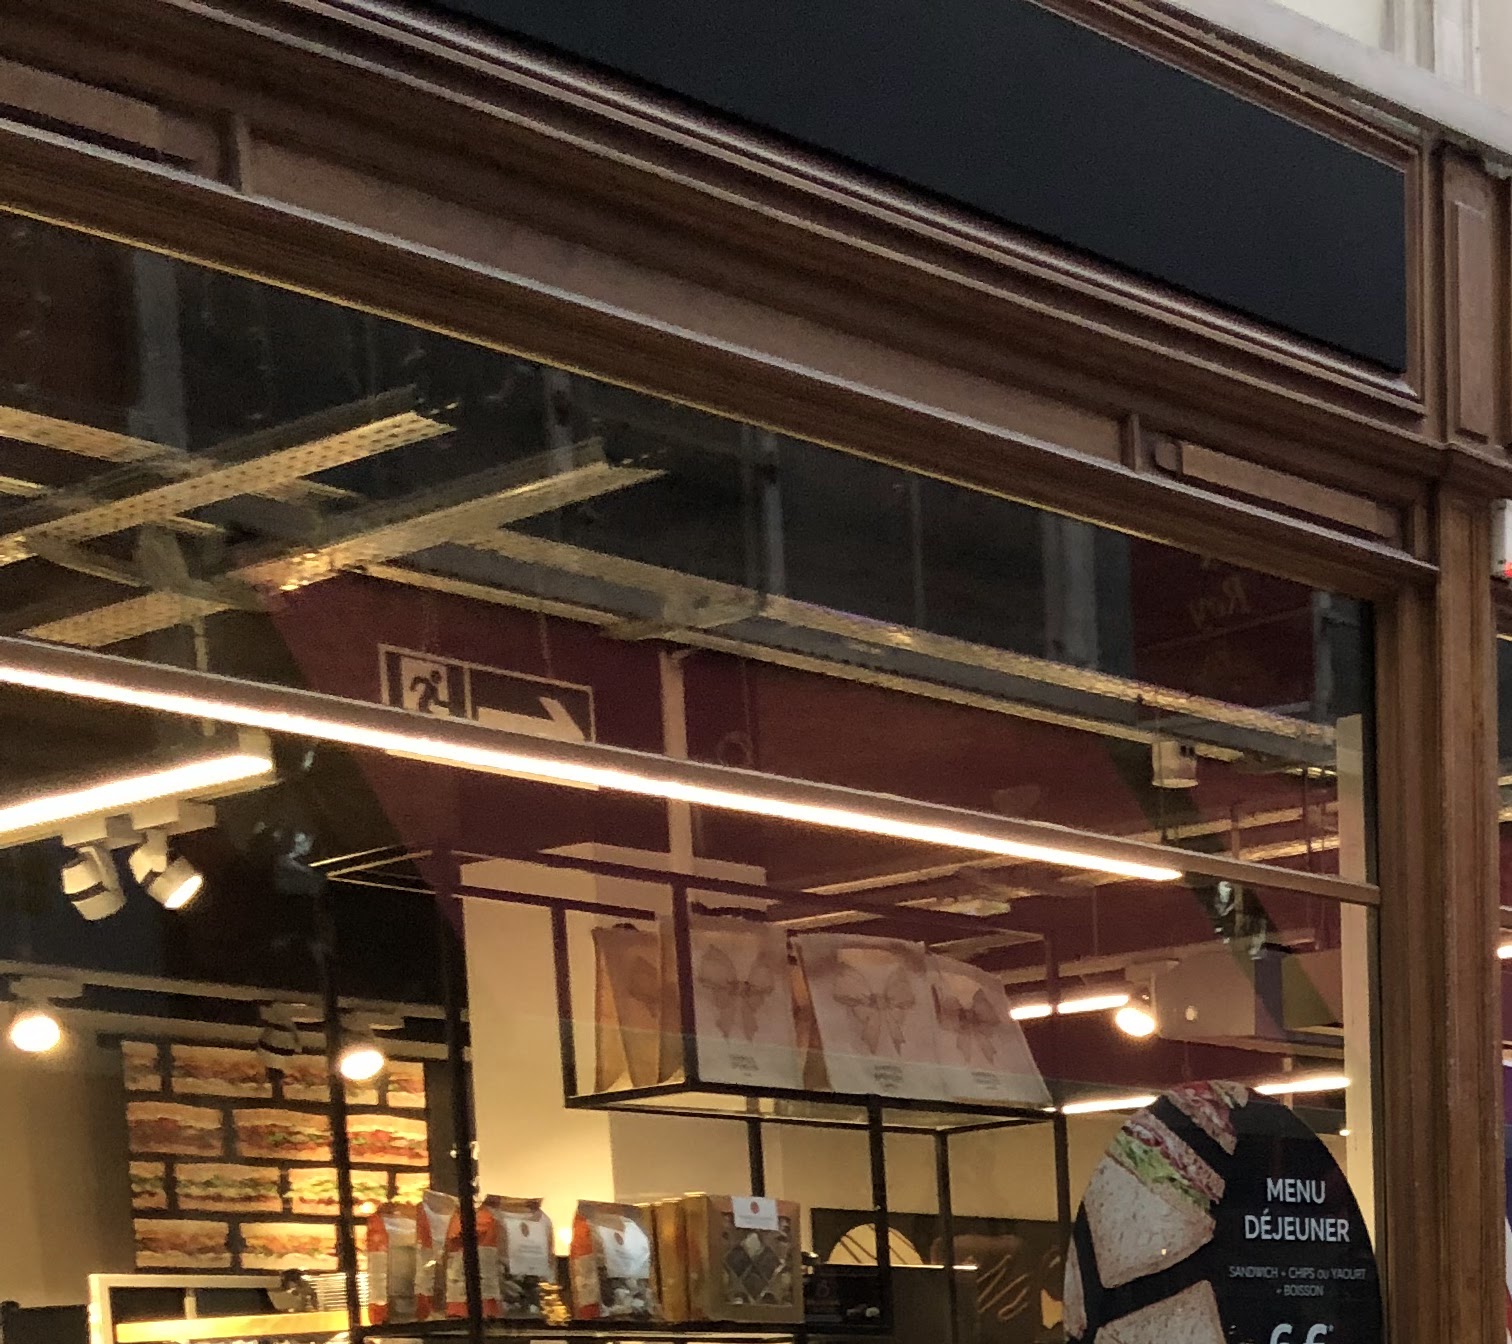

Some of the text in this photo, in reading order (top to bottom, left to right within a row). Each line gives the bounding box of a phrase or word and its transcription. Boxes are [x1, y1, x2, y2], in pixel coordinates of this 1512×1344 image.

[1266, 1177, 1326, 1204] MENU
[1244, 1208, 1350, 1243] DÉJEUNER
[1229, 1266, 1279, 1279] SANDWICH
[1288, 1266, 1315, 1279] CHIPS
[1330, 1267, 1367, 1280] YAOURT
[1283, 1284, 1325, 1297] BOISSON
